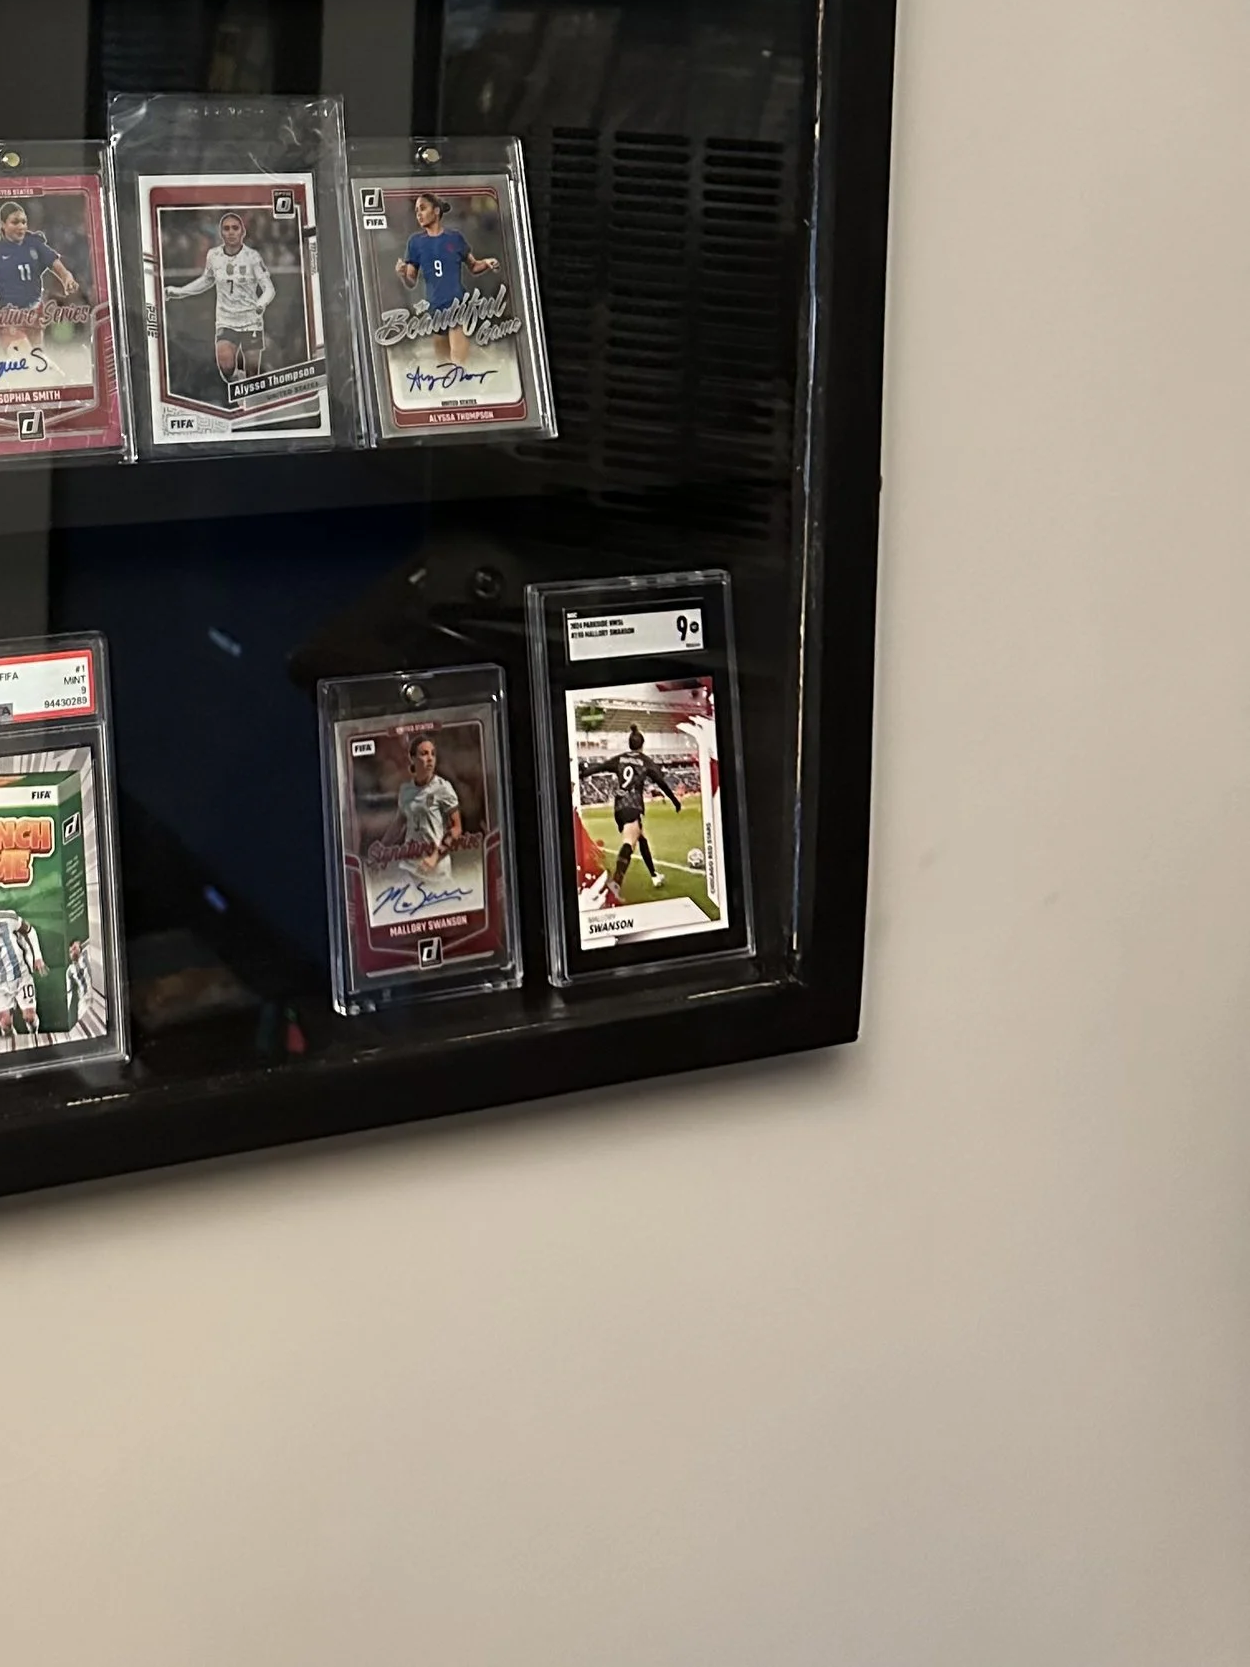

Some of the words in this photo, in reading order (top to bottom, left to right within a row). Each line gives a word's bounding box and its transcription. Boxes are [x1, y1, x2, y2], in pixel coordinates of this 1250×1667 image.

[42, 302, 90, 326] Series
[375, 284, 506, 346] Beautiful
[476, 318, 522, 346] Game
[234, 380, 266, 397] Alyssa
[268, 366, 315, 386] Thompson
[33, 390, 61, 401] SMITH
[171, 419, 193, 429] FIFA
[676, 615, 687, 641] 9
[0, 672, 19, 682] FIFA
[64, 675, 86, 685] MINT
[355, 744, 371, 753] FIFA
[622, 766, 634, 787] 9
[31, 790, 50, 800] FIFA
[390, 923, 427, 937] MALLORY
[429, 915, 468, 932] SWANSON
[589, 919, 634, 934] SWANSON
